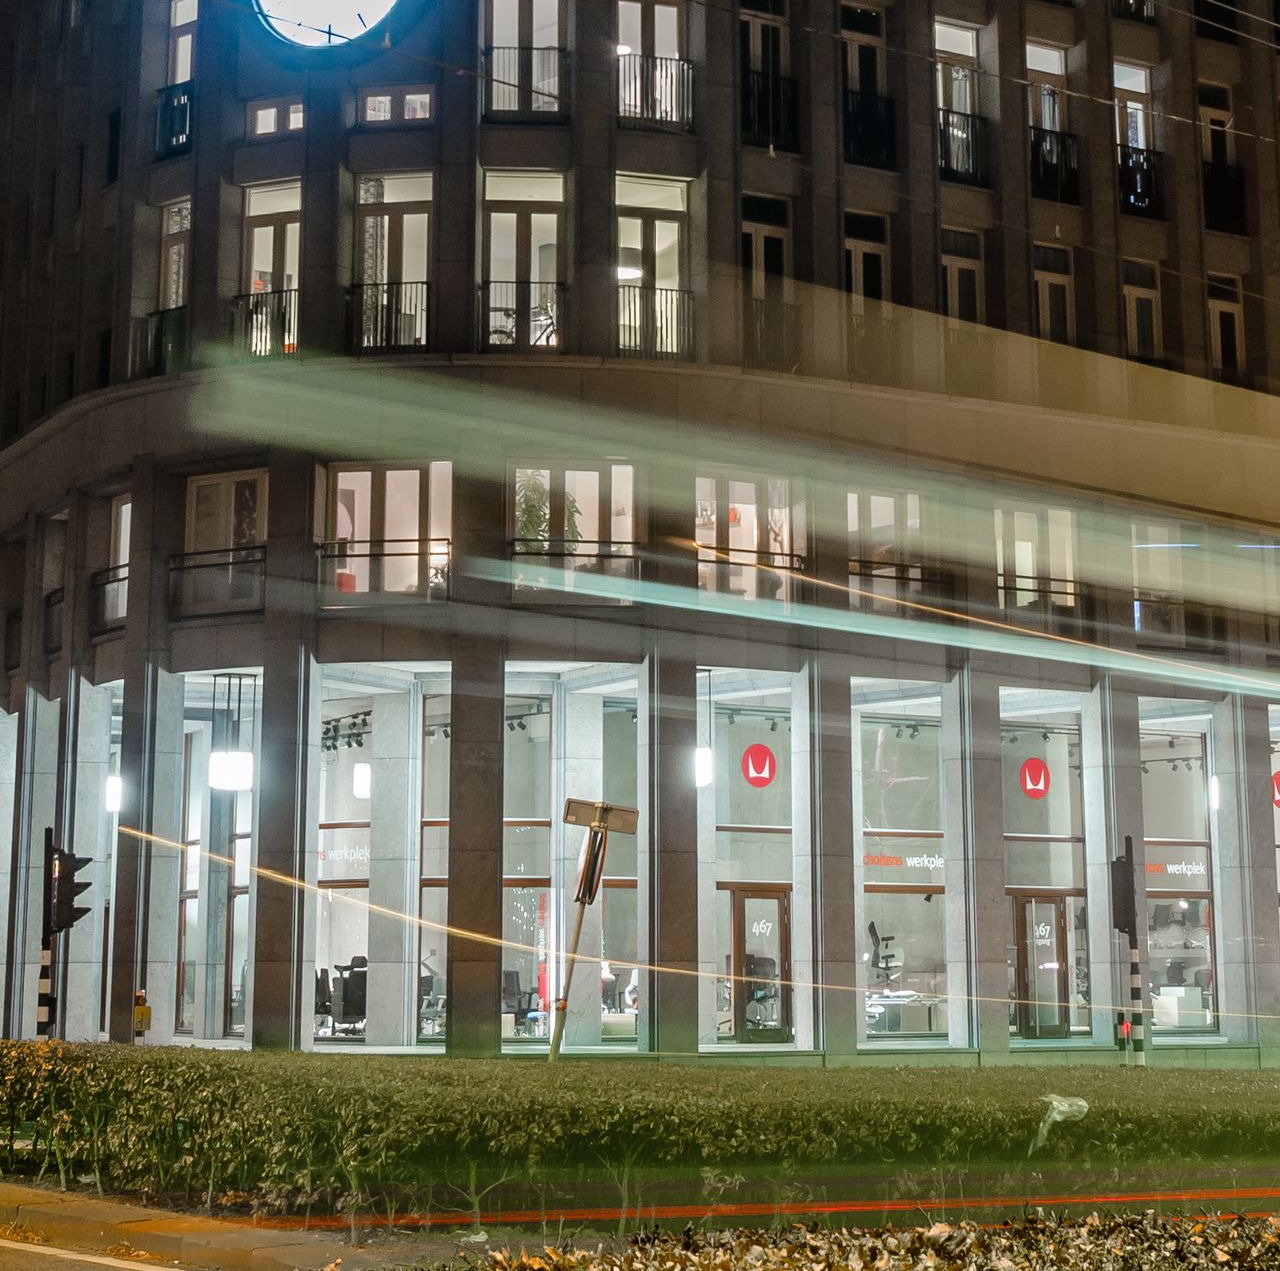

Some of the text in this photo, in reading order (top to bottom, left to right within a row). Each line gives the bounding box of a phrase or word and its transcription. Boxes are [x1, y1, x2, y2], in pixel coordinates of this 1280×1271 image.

[327, 845, 370, 863] werkplek
[906, 853, 944, 870] werkple
[1166, 860, 1206, 877] werkplek
[752, 919, 772, 936] 467
[1034, 922, 1050, 938] 467
